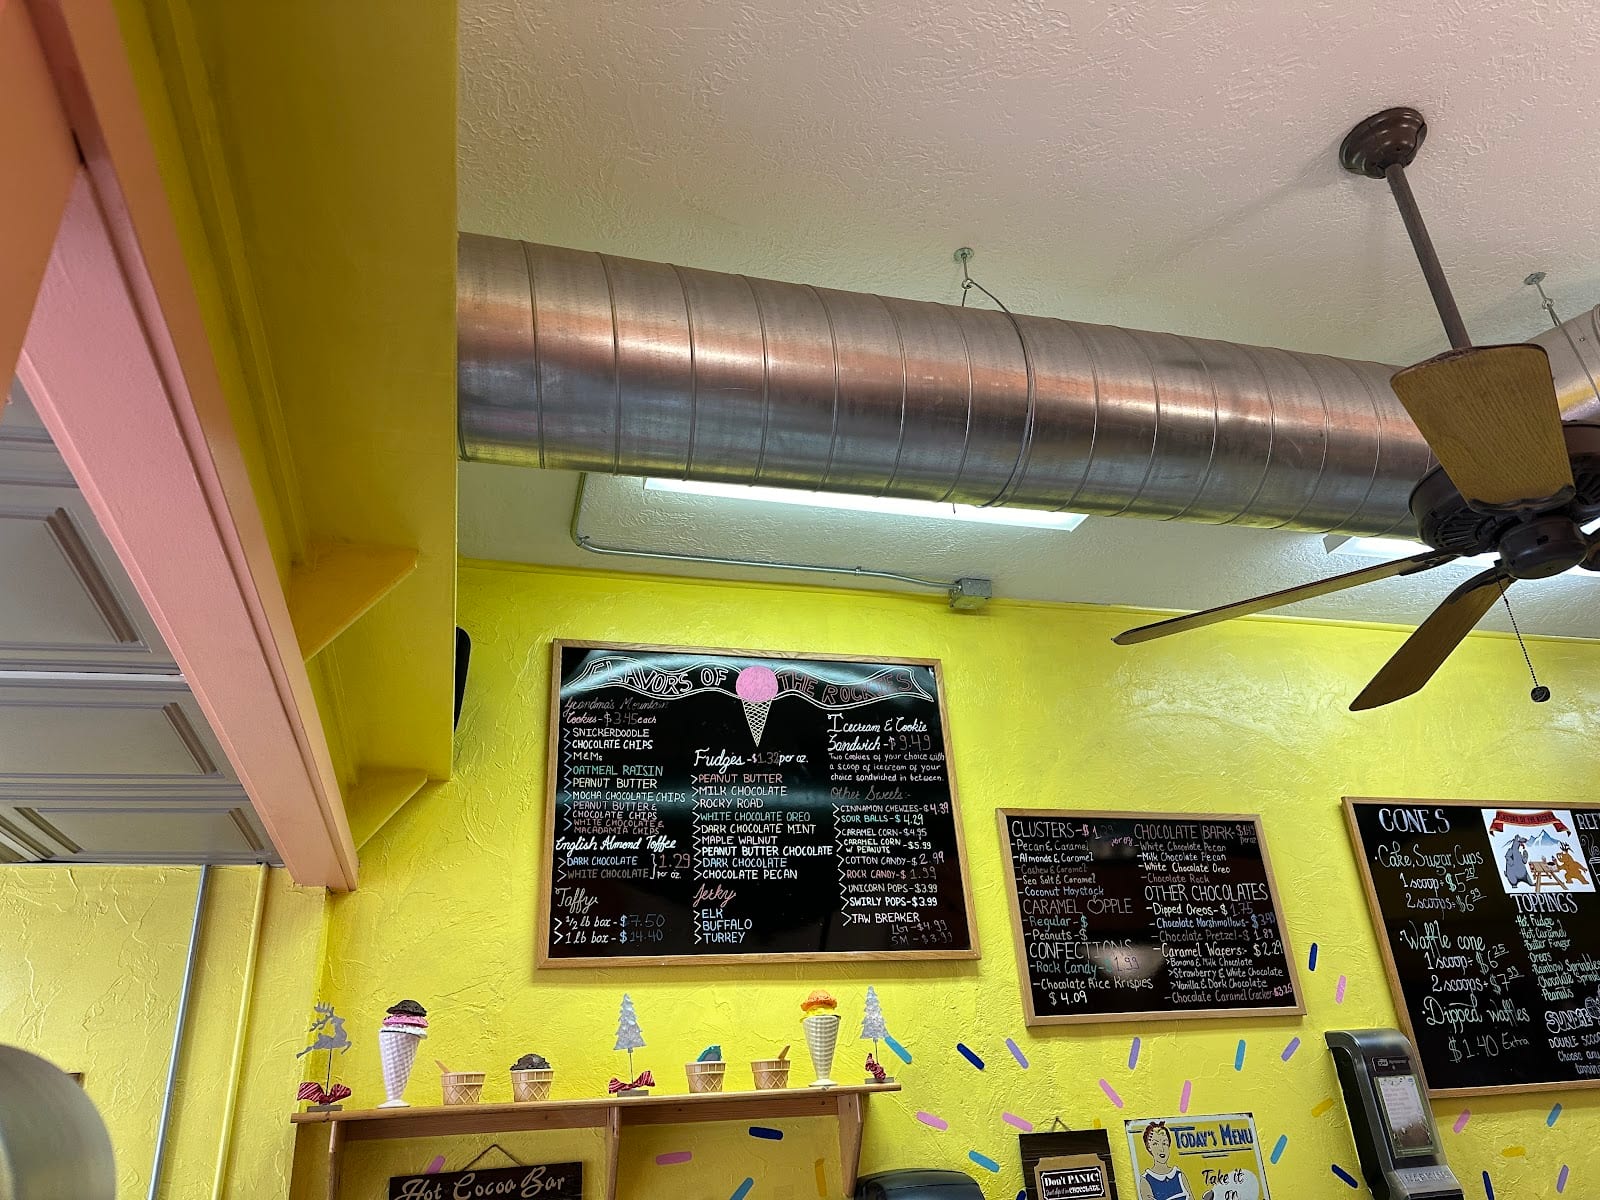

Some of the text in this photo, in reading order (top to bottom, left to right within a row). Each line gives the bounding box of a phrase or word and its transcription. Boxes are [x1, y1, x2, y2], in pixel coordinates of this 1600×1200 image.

[589, 660, 693, 696] FLAVORS
[700, 667, 729, 688] OF
[777, 672, 818, 698] THE
[895, 716, 928, 733] Cookie
[572, 727, 650, 738] SNICKERDOODLE
[572, 739, 654, 750] CHOCOLATE CHIPS
[827, 734, 881, 751] Sandwich
[572, 765, 663, 777] OATMEAL RAISIN
[572, 778, 658, 789] PEANUT BUTTER
[698, 773, 783, 784] PEANUT BUTTER
[572, 791, 686, 803] MOCHA CHOCOLATE CHIPS
[699, 785, 788, 797] MILK CHOCOLATE
[573, 801, 649, 811] PEANUT BUTTER
[699, 798, 764, 809] ROCKY ROAD
[840, 804, 883, 813] CINNAMON
[572, 810, 658, 821] CHOCOLATE CHIPS
[700, 811, 811, 822] WHITE CHOCOLATE OREO
[841, 814, 861, 823] SOUR
[1378, 808, 1451, 834] CONES
[574, 819, 657, 828] WHITE CHOCOLATE
[701, 823, 817, 835] DARK CHOCOLATE MINT
[1012, 820, 1075, 839] CLUSTERS
[574, 827, 660, 836] MACADAMIA CHIPS
[841, 828, 877, 836] CARAMEL
[1134, 823, 1199, 840] CHOCOLATE
[555, 835, 677, 857] English Almond Toffee
[701, 835, 778, 846] MAPLE WALNUT
[844, 838, 901, 854] CARAMEL CORN PEANUTS
[1017, 839, 1090, 852] Pecan Caramel
[1140, 841, 1164, 852] White
[1167, 841, 1201, 851] Chocolate
[1203, 842, 1227, 852] Pecan
[701, 845, 834, 857] PEANUT BUTTER CHOCOLATE
[1019, 851, 1095, 863] Almonds Caramel
[566, 853, 691, 869] DARK CHOCOLATE 1.29
[702, 858, 788, 868] DARK CHOCOLATE
[845, 856, 879, 865] COTTON
[1160, 852, 1198, 862] Chocolate
[1201, 852, 1227, 863] Pecan
[567, 868, 649, 879] WHITE CHOCOLATE
[1144, 861, 1231, 874] White Chocolate Oreo
[702, 869, 798, 880] CHOCOLATE PECAN
[846, 869, 867, 879] ROCK
[1022, 875, 1037, 885] Sea
[1063, 872, 1097, 884] Caramel
[1147, 873, 1210, 884] Chocolate Rock
[848, 884, 885, 893] UNICORN
[1024, 885, 1105, 898] Coconut Haystack
[1144, 882, 1269, 902] OTHER CHOCOLATES
[554, 887, 599, 914] Taffy
[693, 883, 737, 908] Jerky
[849, 897, 882, 907] SWIRLY
[1022, 899, 1084, 915] CARAMEL
[1510, 892, 1578, 914] TOPPINGS
[701, 908, 724, 919] ELK
[1153, 902, 1183, 918] Dipped
[593, 916, 611, 927] box
[851, 912, 920, 924] JAW BREAKER
[1029, 915, 1072, 932] Regular
[1156, 917, 1195, 929] Chocolate
[702, 918, 753, 931] BUFFALO
[591, 931, 609, 944] box
[1032, 929, 1073, 941] Peanuts
[1160, 930, 1202, 942] Chocolate
[1400, 920, 1486, 959] Waffle cone
[1162, 942, 1203, 957] Caramel
[1036, 960, 1097, 979] Rock Candy
[1041, 975, 1154, 992] Chocolate Rice Krispies
[1423, 993, 1483, 1034] Dipped
[1502, 1032, 1530, 1050] Extra
[395, 1165, 566, 1200] Hot Cocoa Bar
[1044, 1172, 1100, 1187] Don't PANIC!
[1202, 1168, 1245, 1186] Take it
